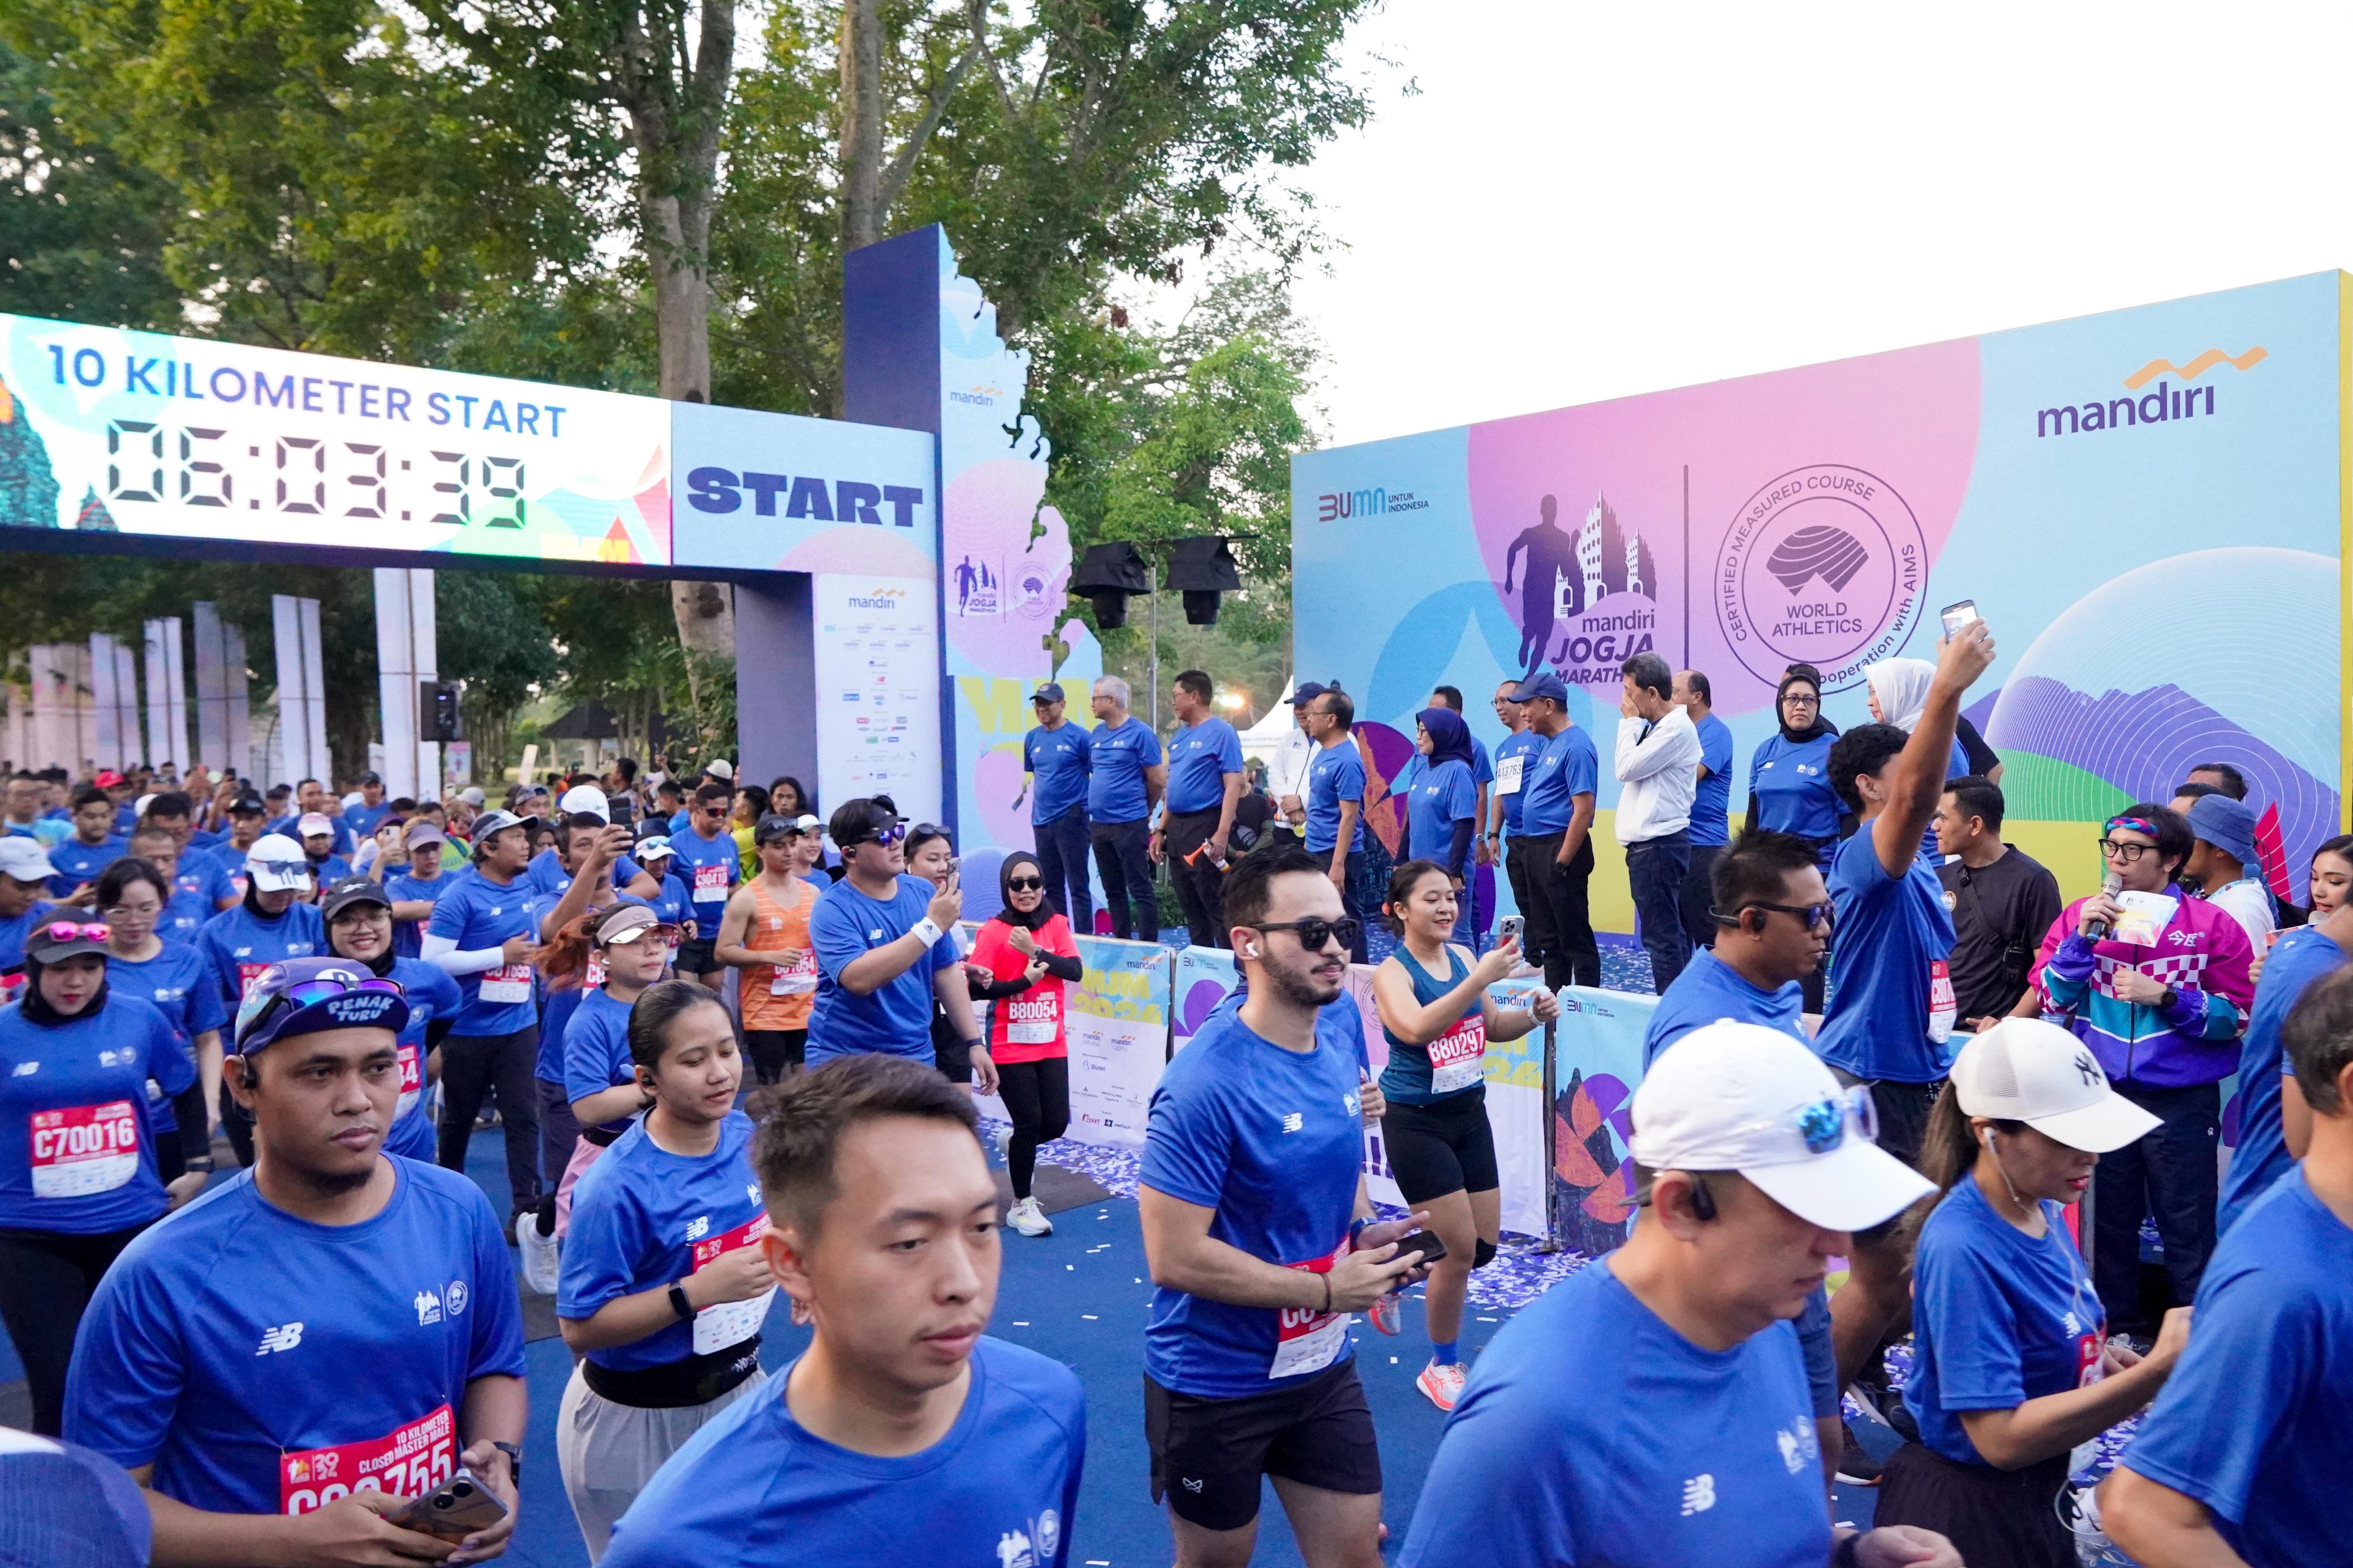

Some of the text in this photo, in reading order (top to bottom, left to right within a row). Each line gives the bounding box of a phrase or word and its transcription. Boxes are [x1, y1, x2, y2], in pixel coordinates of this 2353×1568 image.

[49, 344, 567, 438] 10 KILOMETER START
[950, 390, 993, 407] mandiri
[2037, 382, 2214, 438] mandiri
[109, 420, 525, 528] 06:03:39
[687, 466, 923, 528] START
[1319, 487, 1414, 522] BUMN UNTUK
[1389, 500, 1429, 513] INDONESIA
[1725, 476, 1876, 641] CERTIFIED MEASURED COURSE
[849, 596, 895, 609] mandiri
[969, 599, 997, 607] JOGJA
[1786, 602, 1847, 618] WORLD
[1820, 544, 1917, 683] ooperation with AIMS
[1583, 608, 1655, 633] mandiri
[1772, 619, 1862, 637] ATHLETICS
[1550, 633, 1653, 664] JOGJA
[1555, 668, 1623, 684] MARATH
[1127, 961, 1156, 970] mandiri
[327, 995, 394, 1015] PENAK
[338, 1009, 382, 1022] TURU
[1009, 1000, 1057, 1020] B80054
[1567, 999, 1597, 1016] BUMN
[1428, 1026, 1484, 1062] B80297
[35, 1117, 135, 1158] C70016
[396, 1410, 449, 1444] 10 KILOMETER
[359, 1422, 450, 1474] CLOSED MASTER MALE
